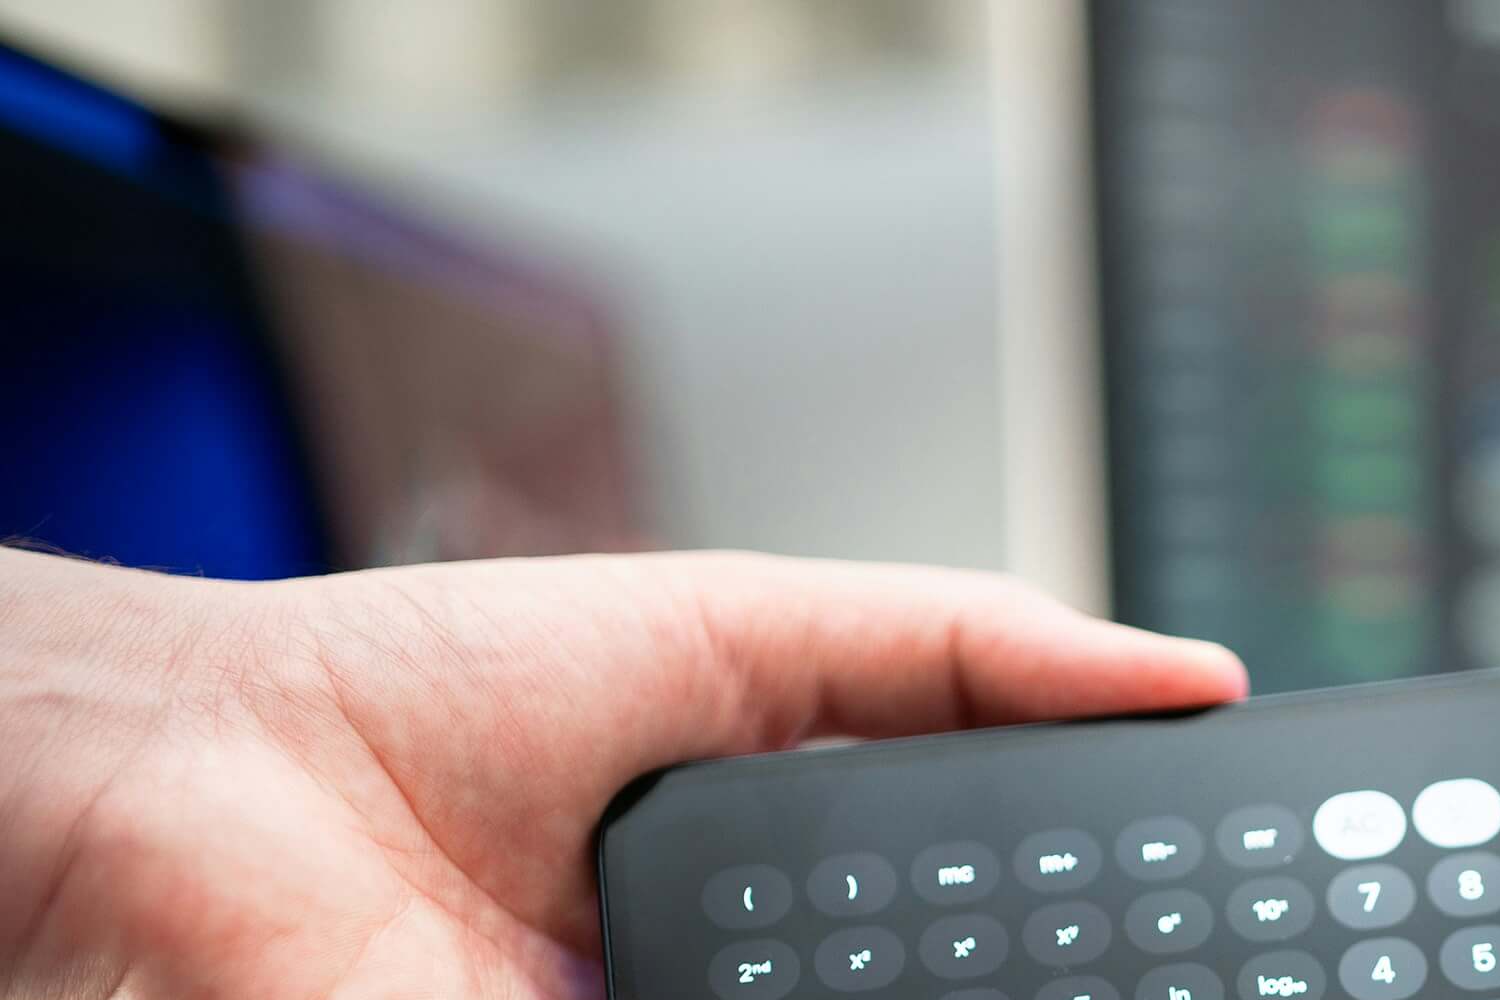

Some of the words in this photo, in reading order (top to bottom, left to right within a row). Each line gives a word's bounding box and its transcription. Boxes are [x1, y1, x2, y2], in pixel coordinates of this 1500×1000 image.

[743, 886, 755, 911] (
[846, 874, 858, 900] )
[938, 864, 976, 886] mc
[737, 960, 772, 983] 2nd
[1357, 880, 1381, 912] 7
[1457, 868, 1485, 900] 8
[1370, 954, 1397, 984] 4
[1471, 942, 1497, 973] 5
